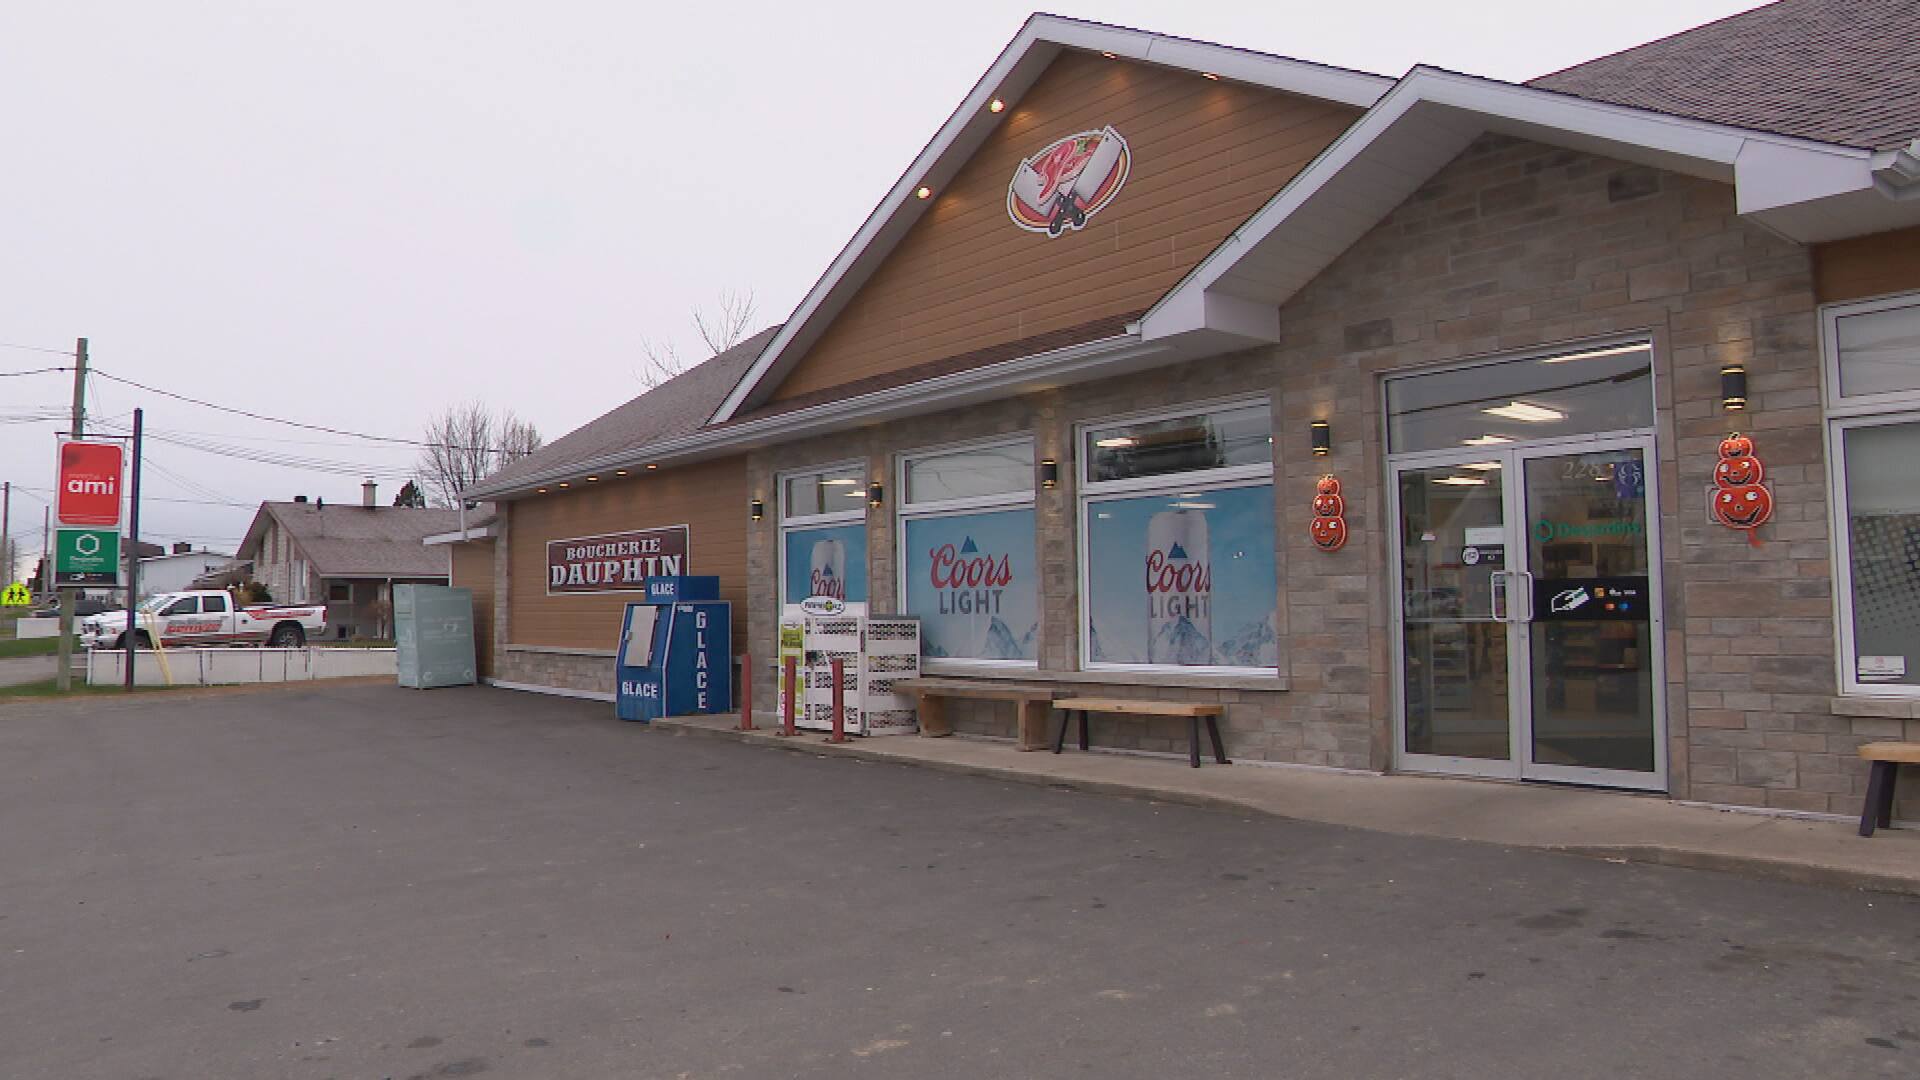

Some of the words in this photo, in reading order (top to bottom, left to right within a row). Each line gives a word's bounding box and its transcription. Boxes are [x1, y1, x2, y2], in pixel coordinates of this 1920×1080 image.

[67, 476, 115, 494] ami
[566, 538, 661, 560] BOUCHERIE
[551, 554, 682, 586] DAUPHIN
[930, 543, 1012, 589] Coors
[1145, 549, 1211, 593] Coors
[651, 583, 675, 595] GLACE
[939, 590, 1003, 614] LIGHT
[1150, 595, 1209, 618] LIGHT
[696, 611, 707, 708] GLACE
[622, 682, 658, 698] GLACE
